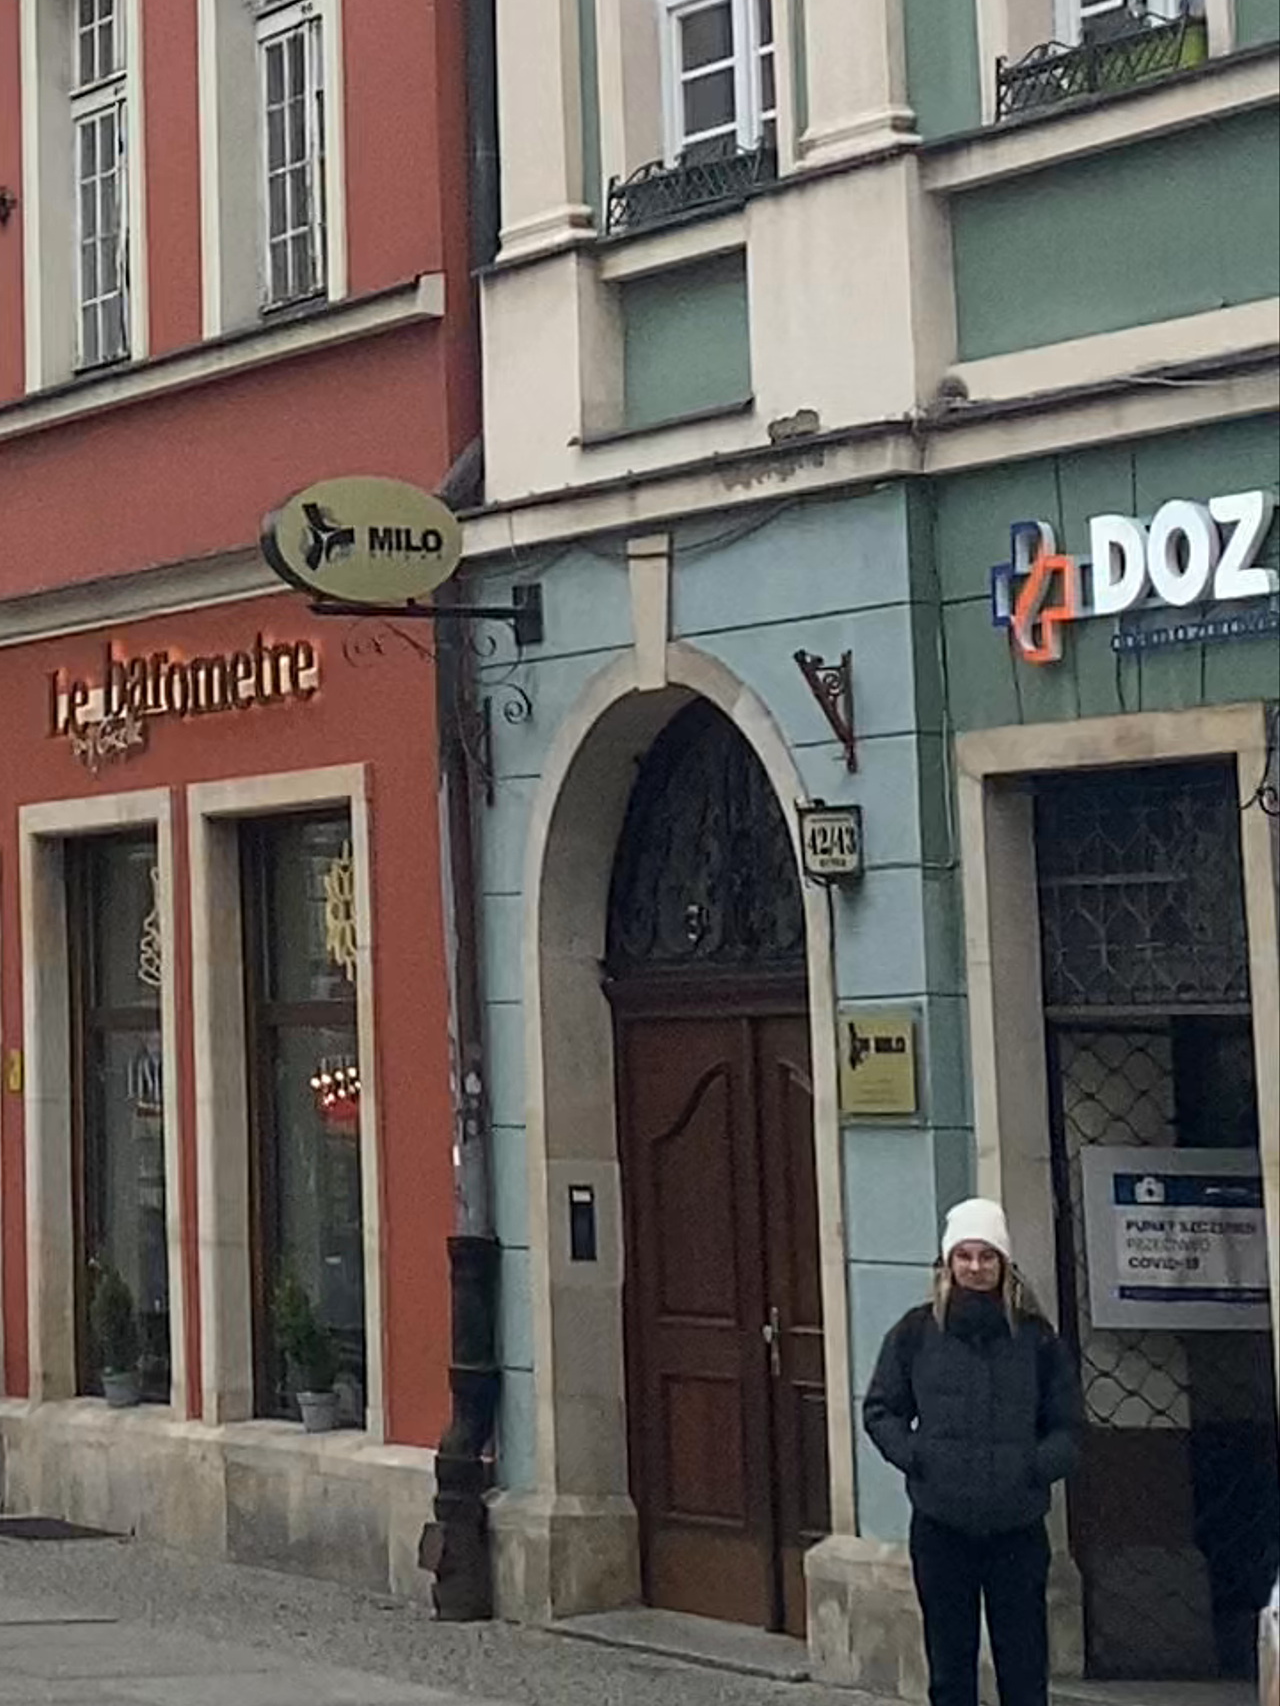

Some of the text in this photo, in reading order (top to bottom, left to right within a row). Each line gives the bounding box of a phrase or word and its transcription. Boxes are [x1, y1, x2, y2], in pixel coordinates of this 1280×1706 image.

[368, 526, 443, 553] MILO
[1089, 490, 1275, 616] DOZ
[45, 668, 90, 737] Le
[1128, 1257, 1200, 1271] COVID-19
